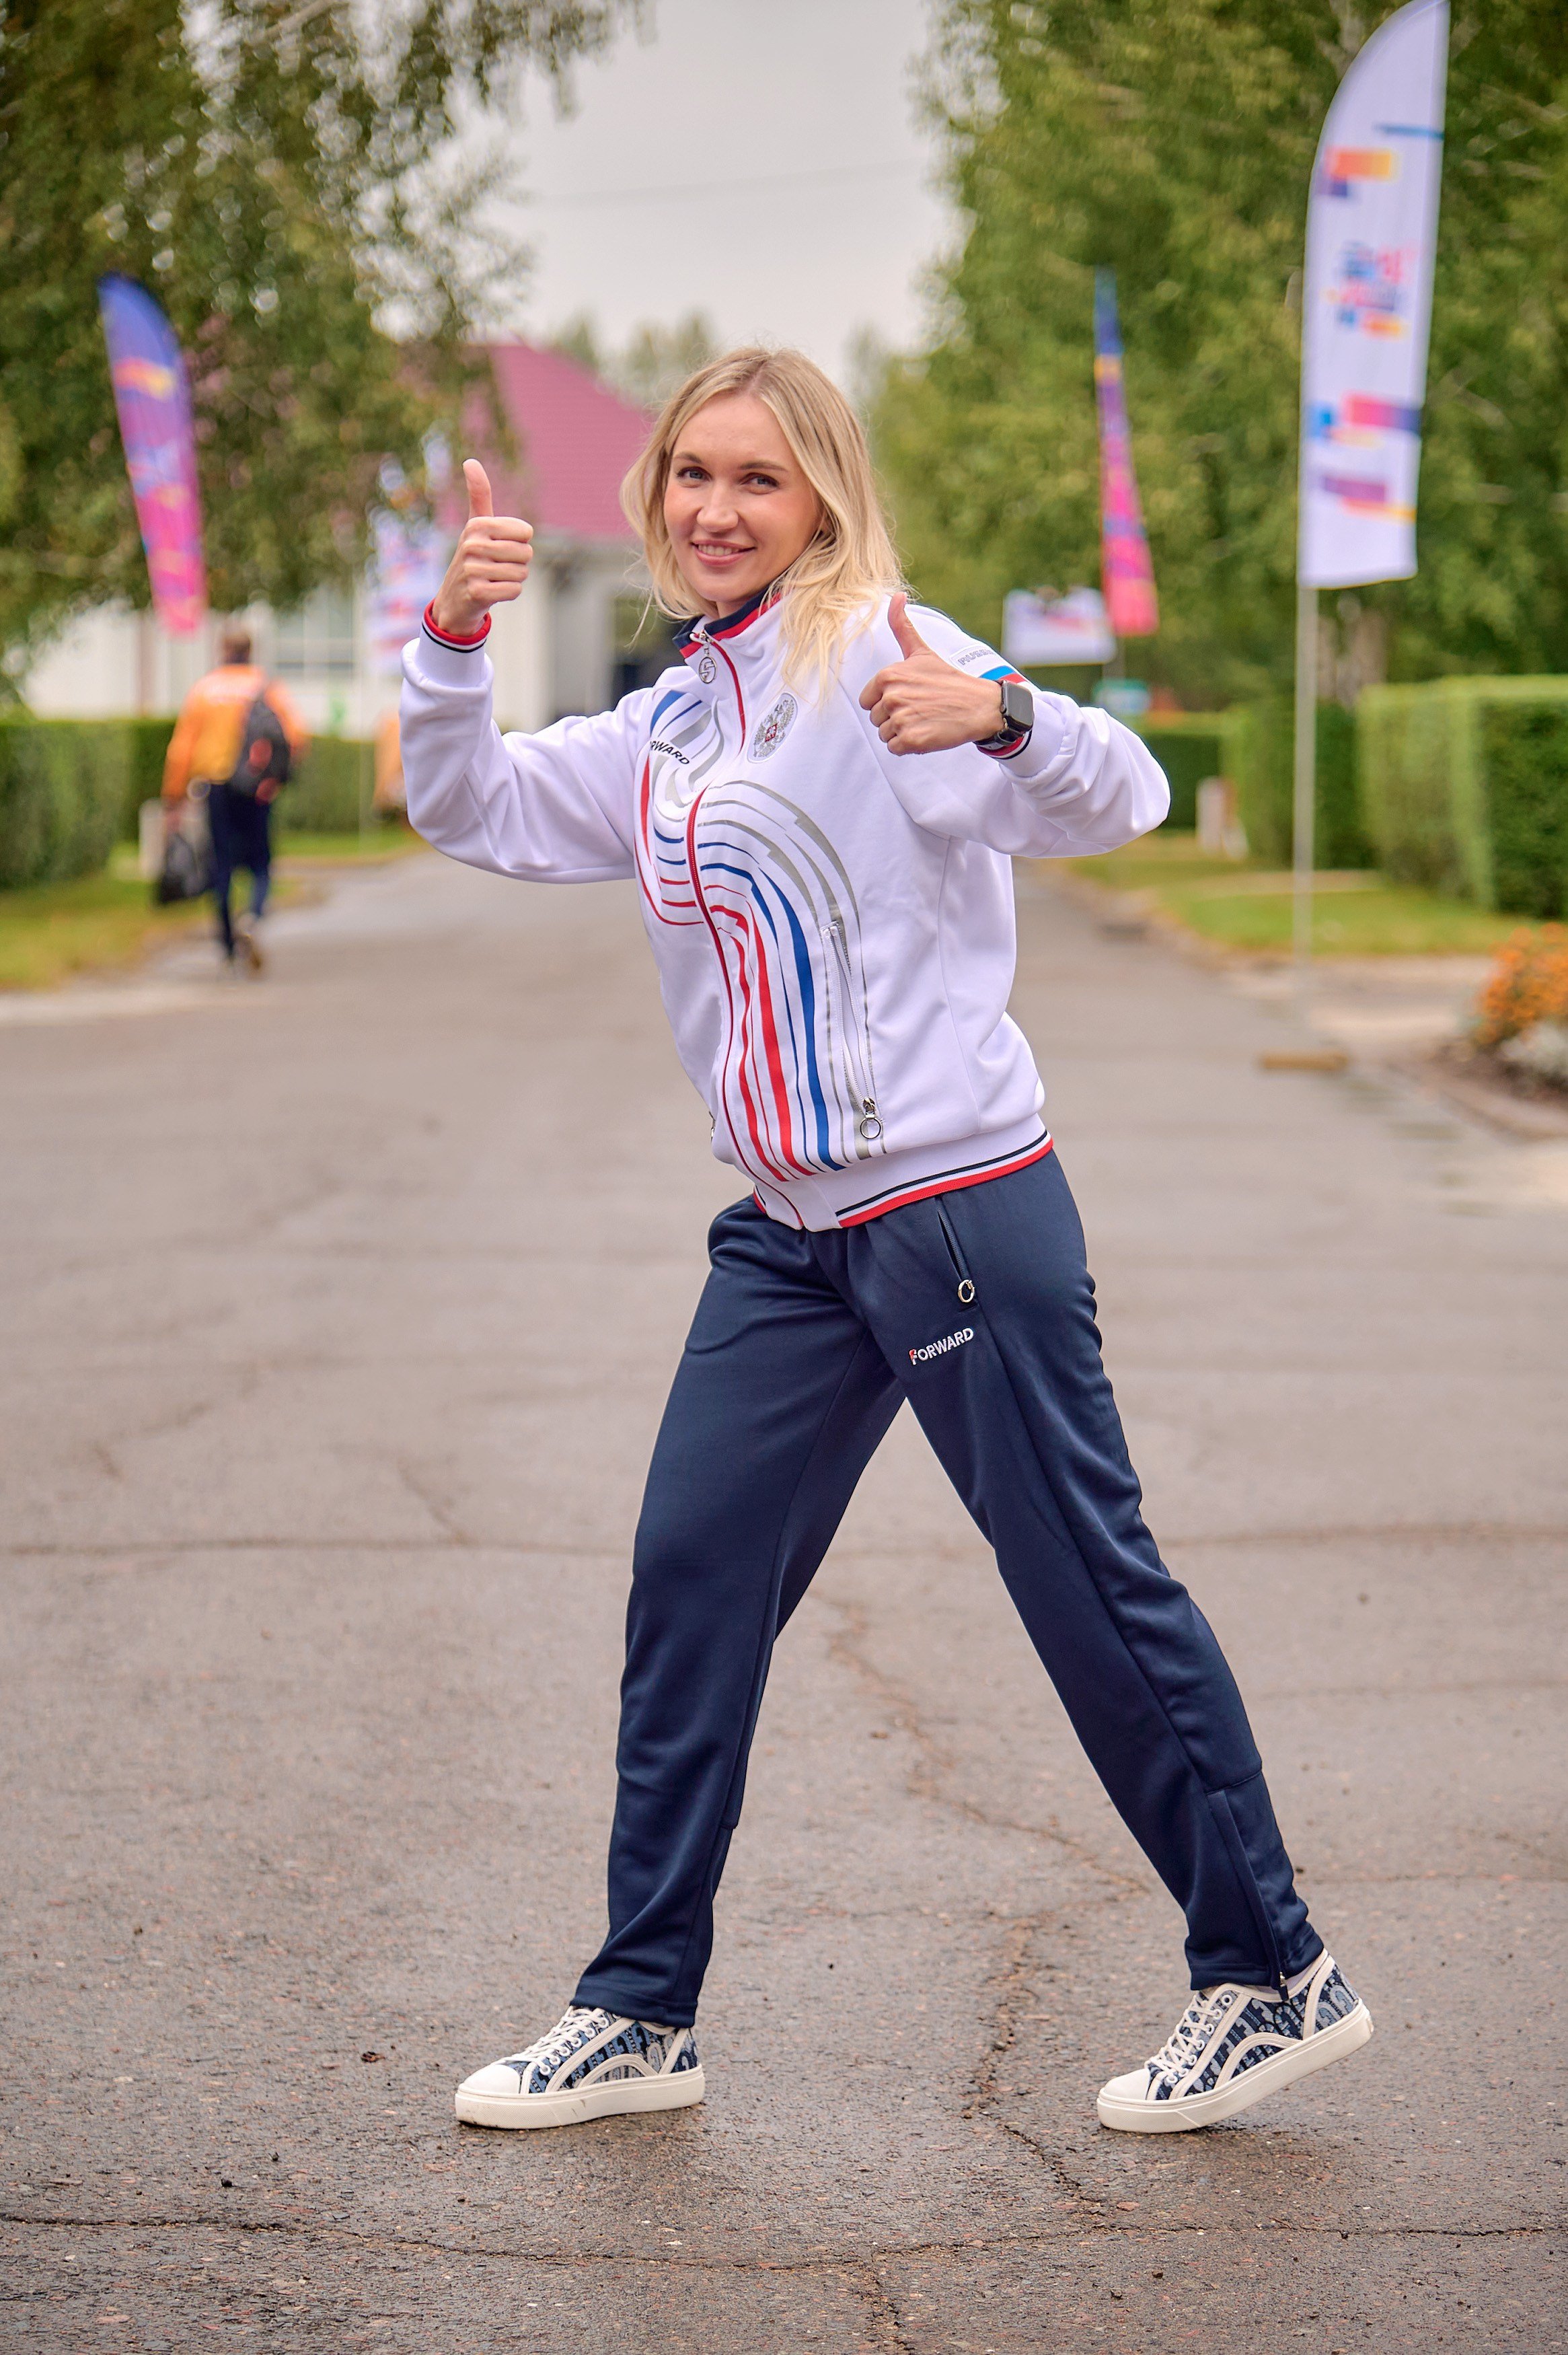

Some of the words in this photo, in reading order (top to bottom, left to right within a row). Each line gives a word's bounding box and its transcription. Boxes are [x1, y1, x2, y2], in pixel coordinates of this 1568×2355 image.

[958, 649, 995, 665] RUSS
[650, 741, 689, 764] RWARD
[909, 1328, 973, 1365] FORWARD
